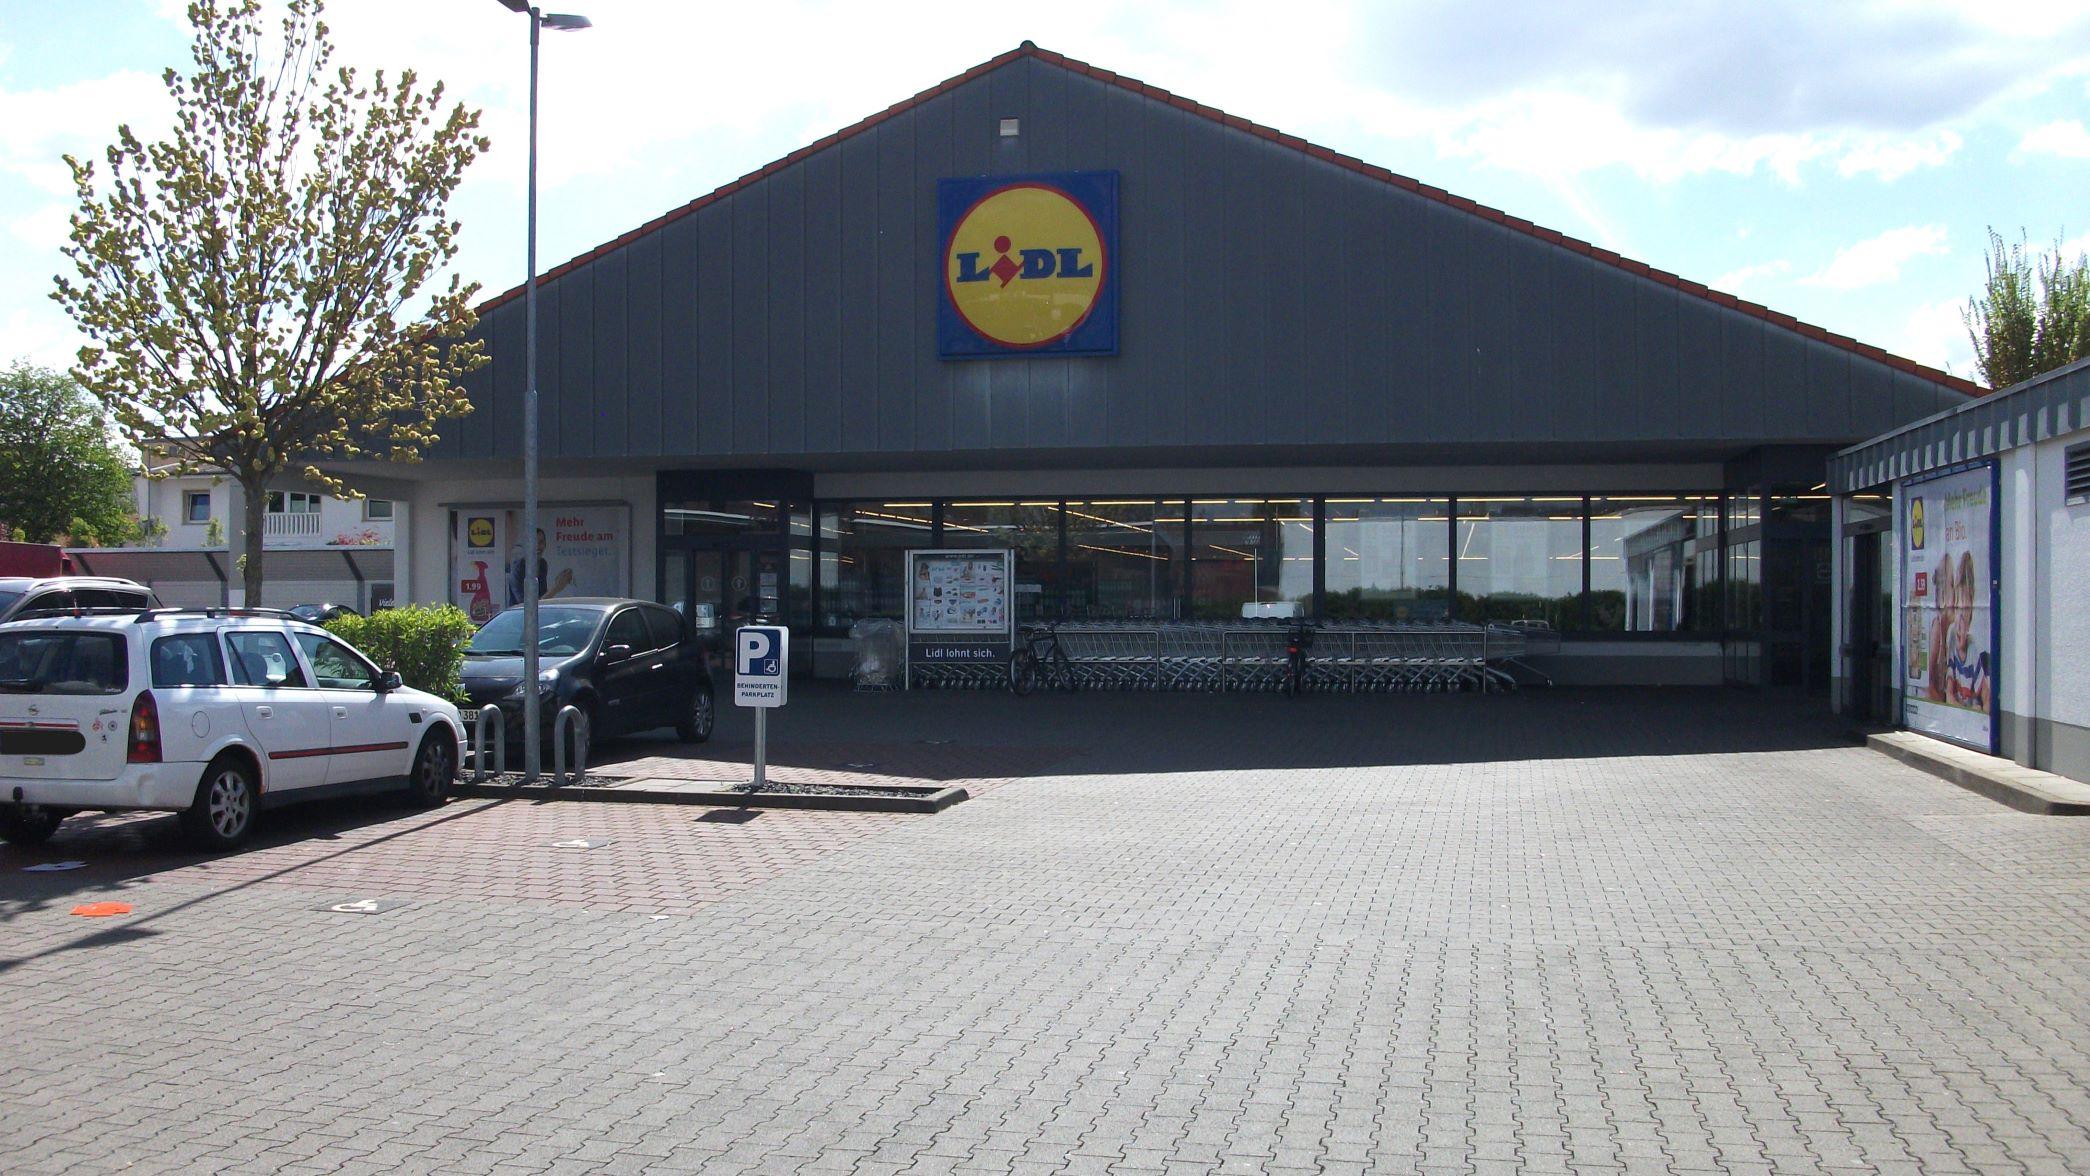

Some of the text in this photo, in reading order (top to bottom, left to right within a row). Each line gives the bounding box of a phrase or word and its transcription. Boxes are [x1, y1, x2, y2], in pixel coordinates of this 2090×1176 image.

[556, 516, 584, 528] Mehr
[556, 530, 614, 542] Freude am
[739, 632, 770, 674] P
[925, 648, 996, 658] Lidl lohnt sich.
